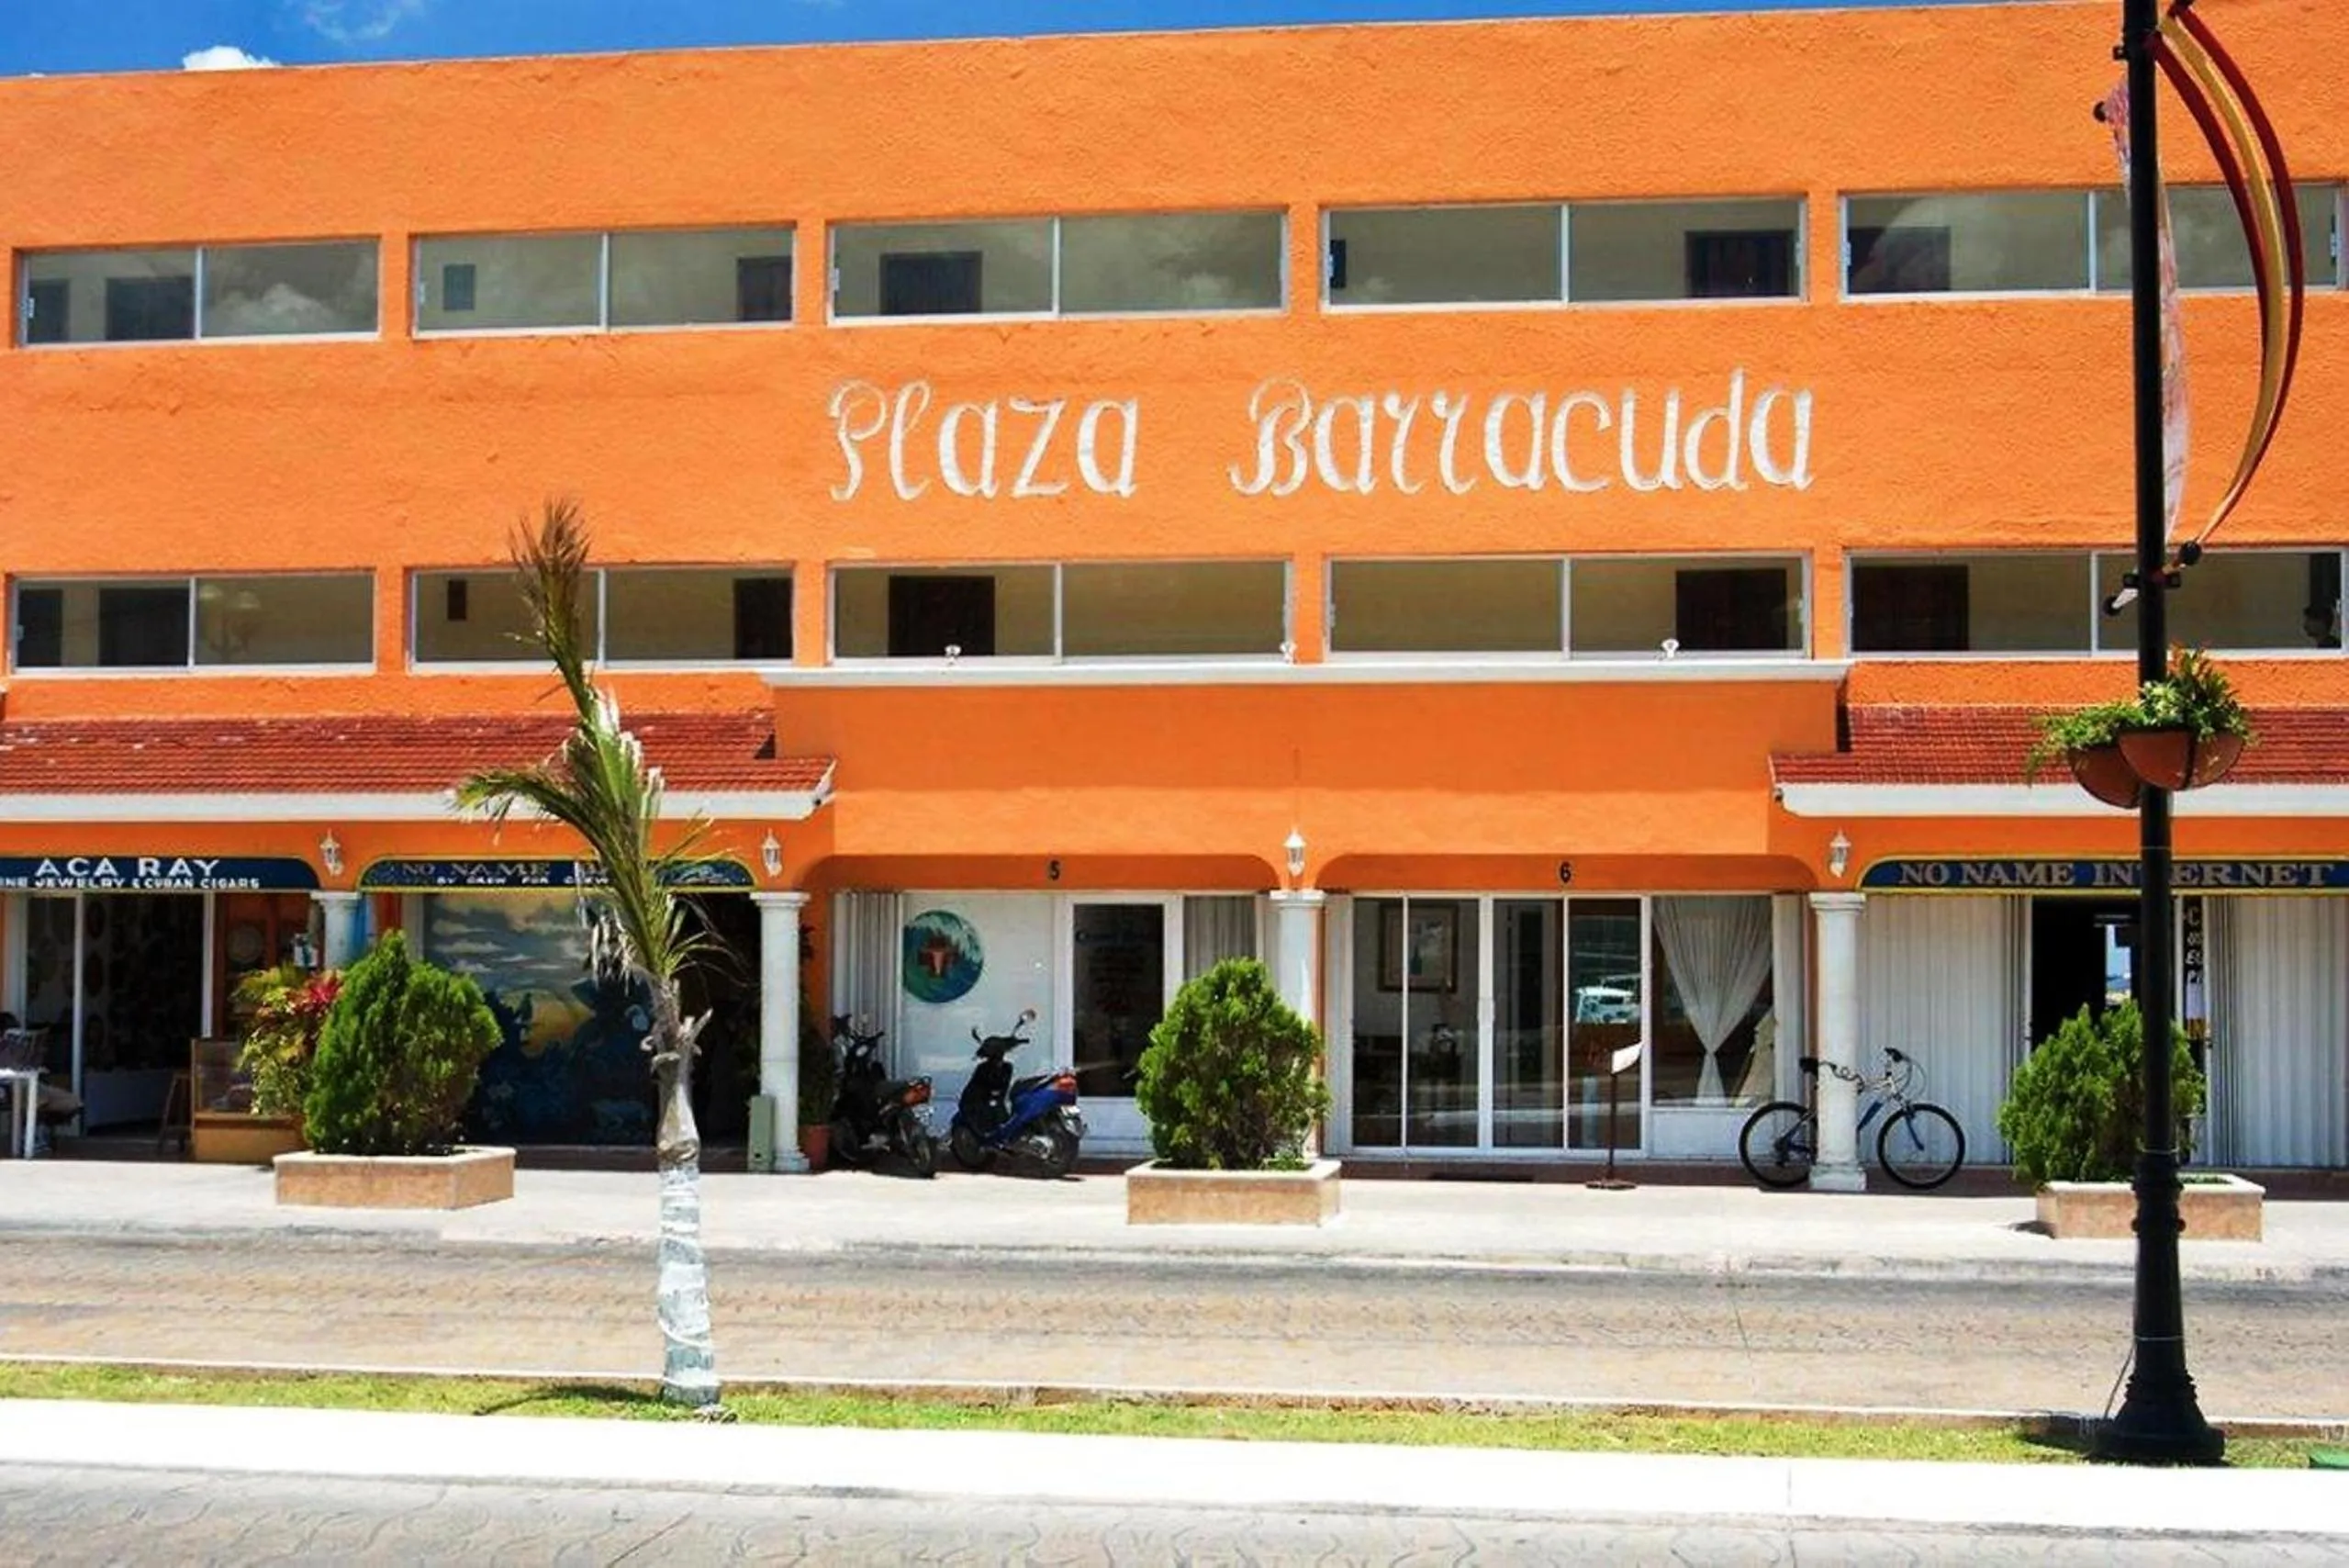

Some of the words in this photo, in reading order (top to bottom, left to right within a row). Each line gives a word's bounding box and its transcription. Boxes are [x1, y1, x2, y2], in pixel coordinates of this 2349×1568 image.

[829, 378, 1138, 501] Plaza
[1226, 366, 1815, 498] Barracuda
[34, 857, 119, 878] ACA
[138, 857, 220, 878] RAY
[1049, 859, 1061, 881] 5
[1560, 861, 1572, 883] 6
[1898, 862, 1952, 886] NO
[1960, 862, 2076, 886] NAME
[2092, 862, 2335, 887] INERNET
[199, 878, 261, 889] CIGARS
